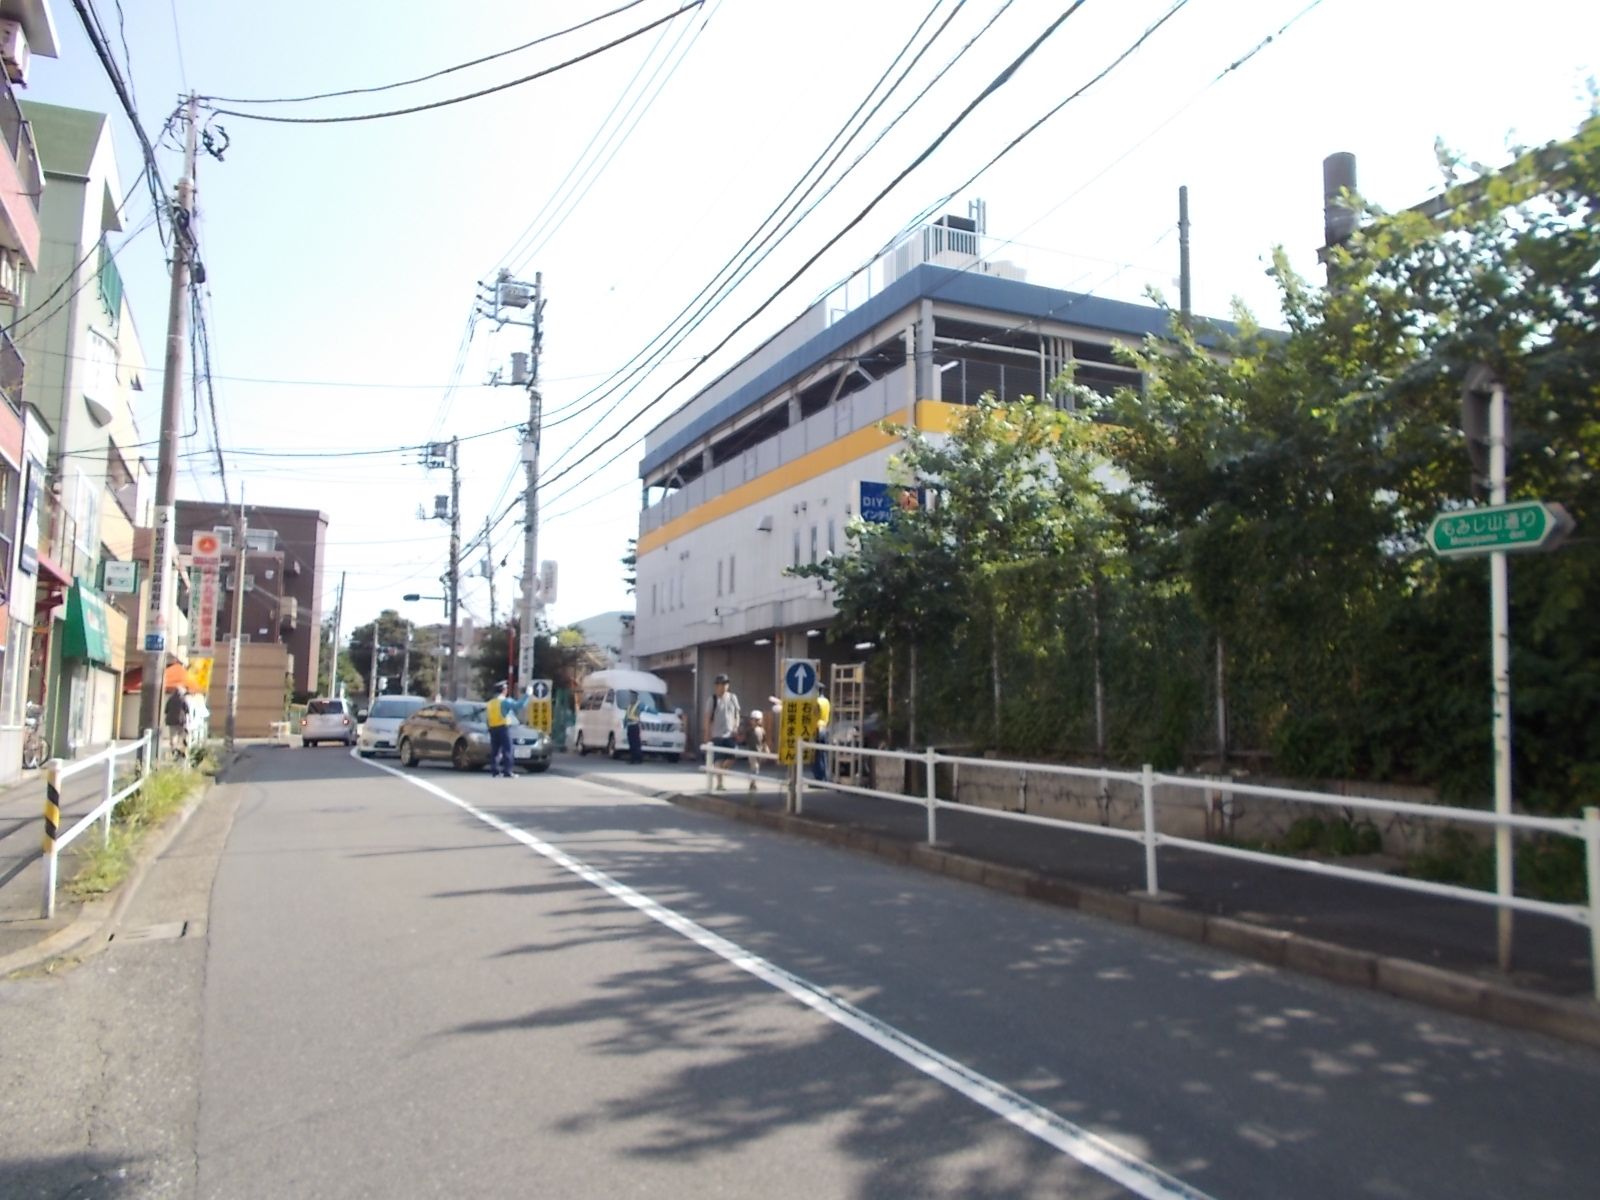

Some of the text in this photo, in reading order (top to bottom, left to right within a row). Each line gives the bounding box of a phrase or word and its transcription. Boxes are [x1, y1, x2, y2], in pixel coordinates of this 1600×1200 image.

[863, 496, 883, 508] DIY
[863, 510, 902, 522] インテリ
[1443, 510, 1536, 536] もみじ山通り
